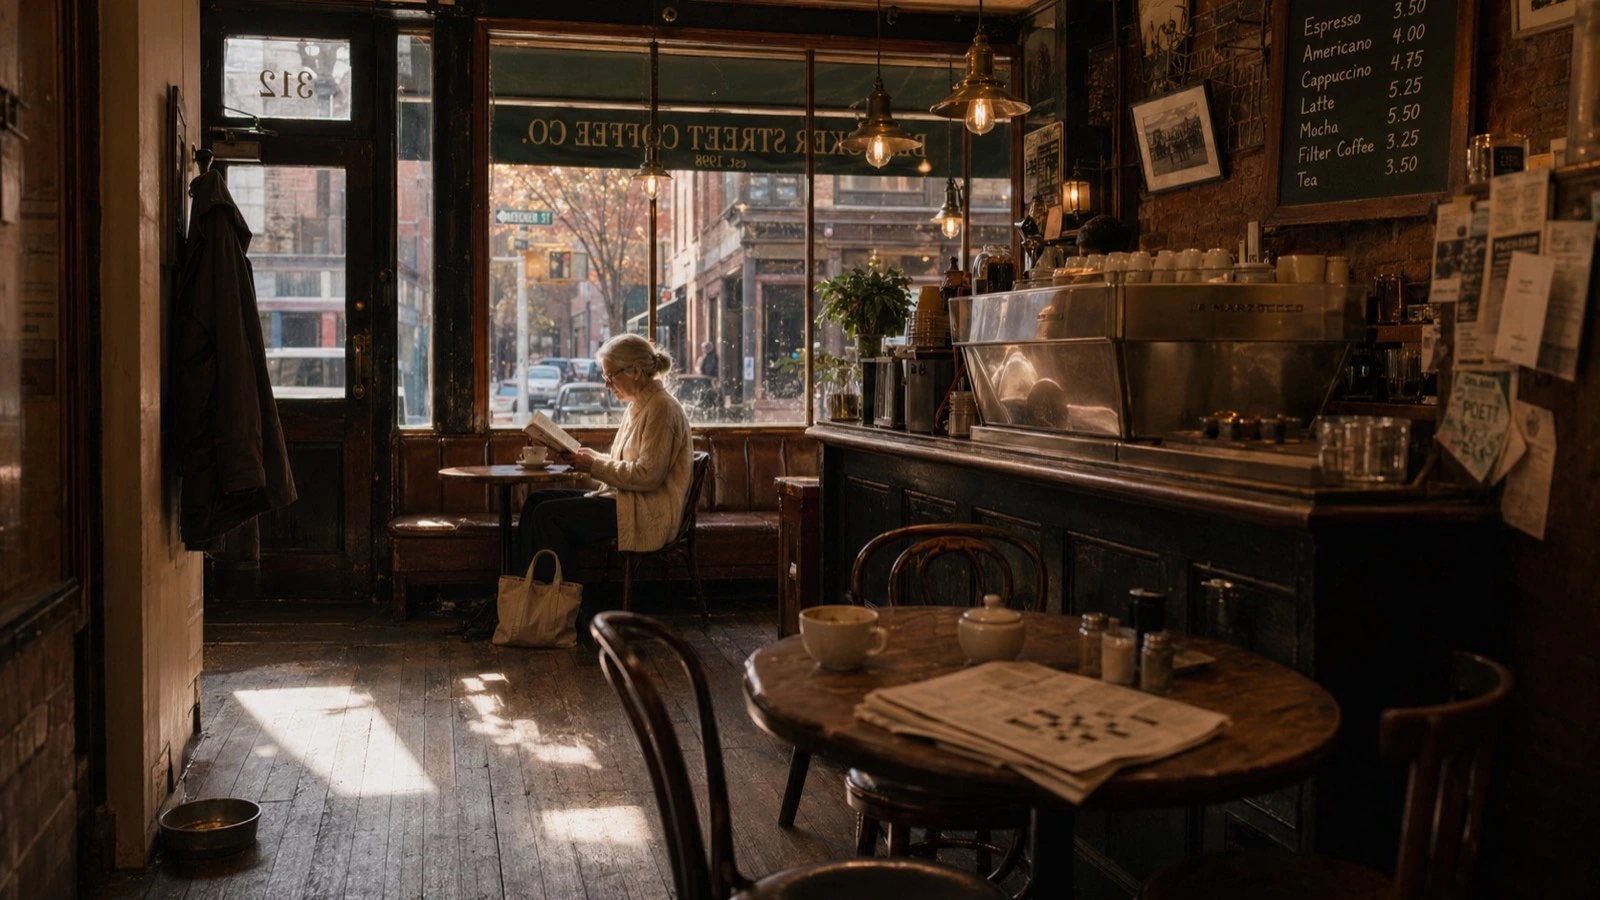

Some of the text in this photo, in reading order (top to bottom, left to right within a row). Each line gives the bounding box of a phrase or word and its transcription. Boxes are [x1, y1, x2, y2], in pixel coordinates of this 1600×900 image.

[1304, 0, 1426, 39] Espresso 3.50
[1302, 23, 1426, 63] Americano 4.00
[1301, 49, 1424, 92] Cappuccino 4.75
[1300, 76, 1423, 115] Latte 5.25
[1299, 103, 1421, 140] Mocha 5.50
[1298, 129, 1420, 164] Filter Coffee 3.25
[1297, 155, 1418, 188] Tea 3.50
